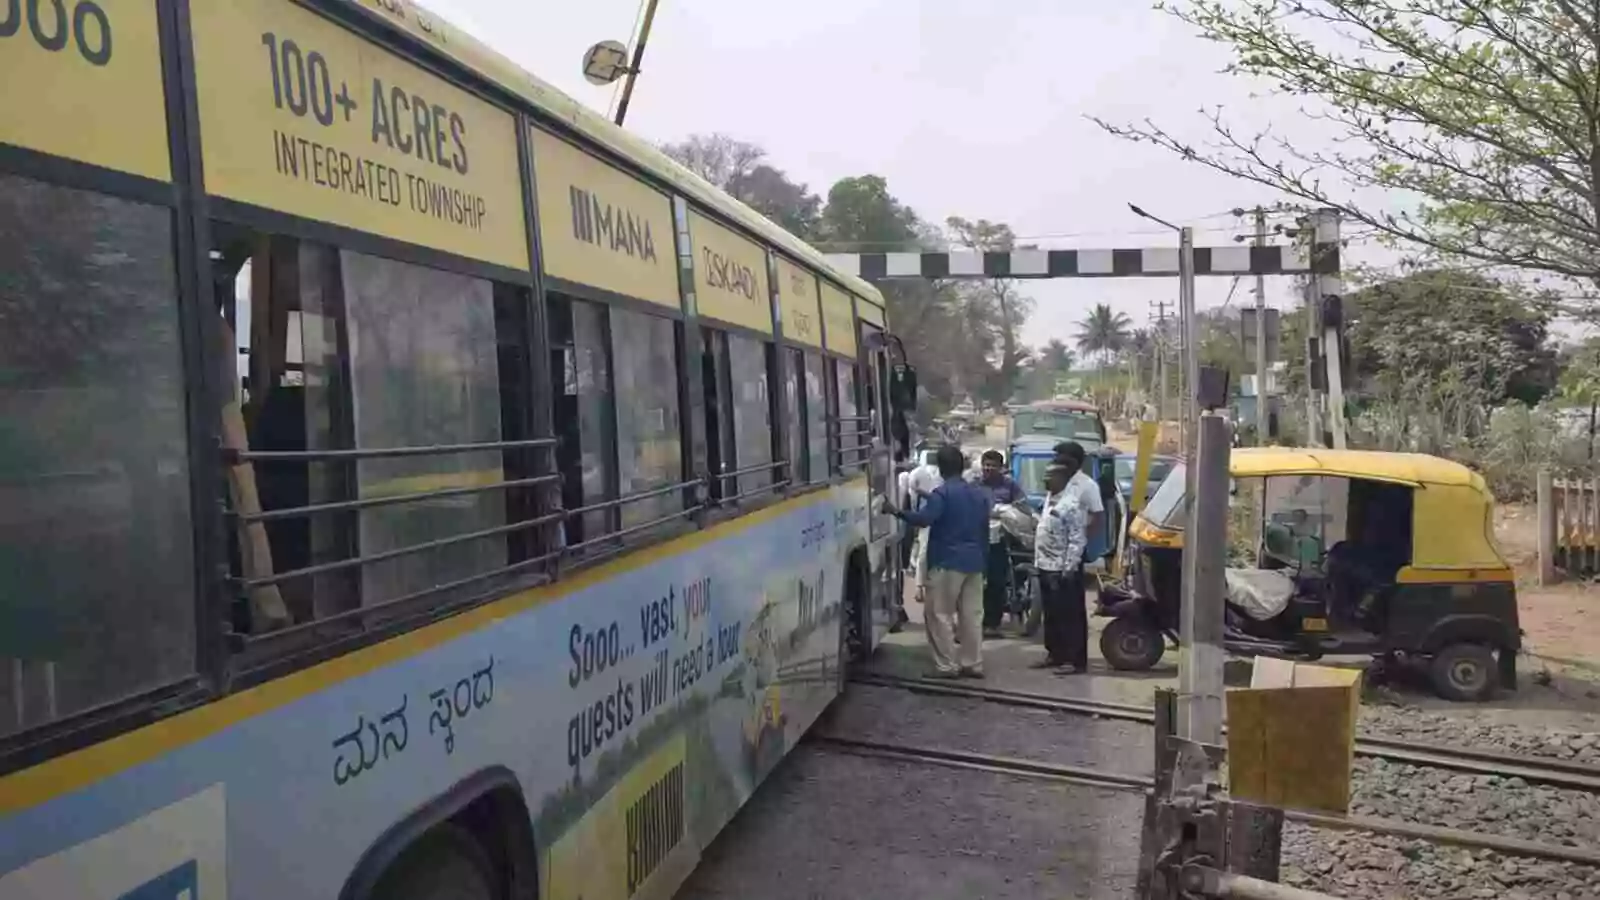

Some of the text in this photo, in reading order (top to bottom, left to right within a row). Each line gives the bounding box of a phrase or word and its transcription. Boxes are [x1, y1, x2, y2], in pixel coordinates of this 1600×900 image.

[262, 32, 468, 176] 100+ ACRES
[273, 129, 486, 233] INTEGRATED TOWNSHIP
[592, 192, 657, 265] MANA
[683, 576, 711, 640] your
[640, 649, 669, 716] will
[672, 630, 705, 697] need
[706, 636, 715, 673] a
[332, 693, 408, 786] ಮನ
